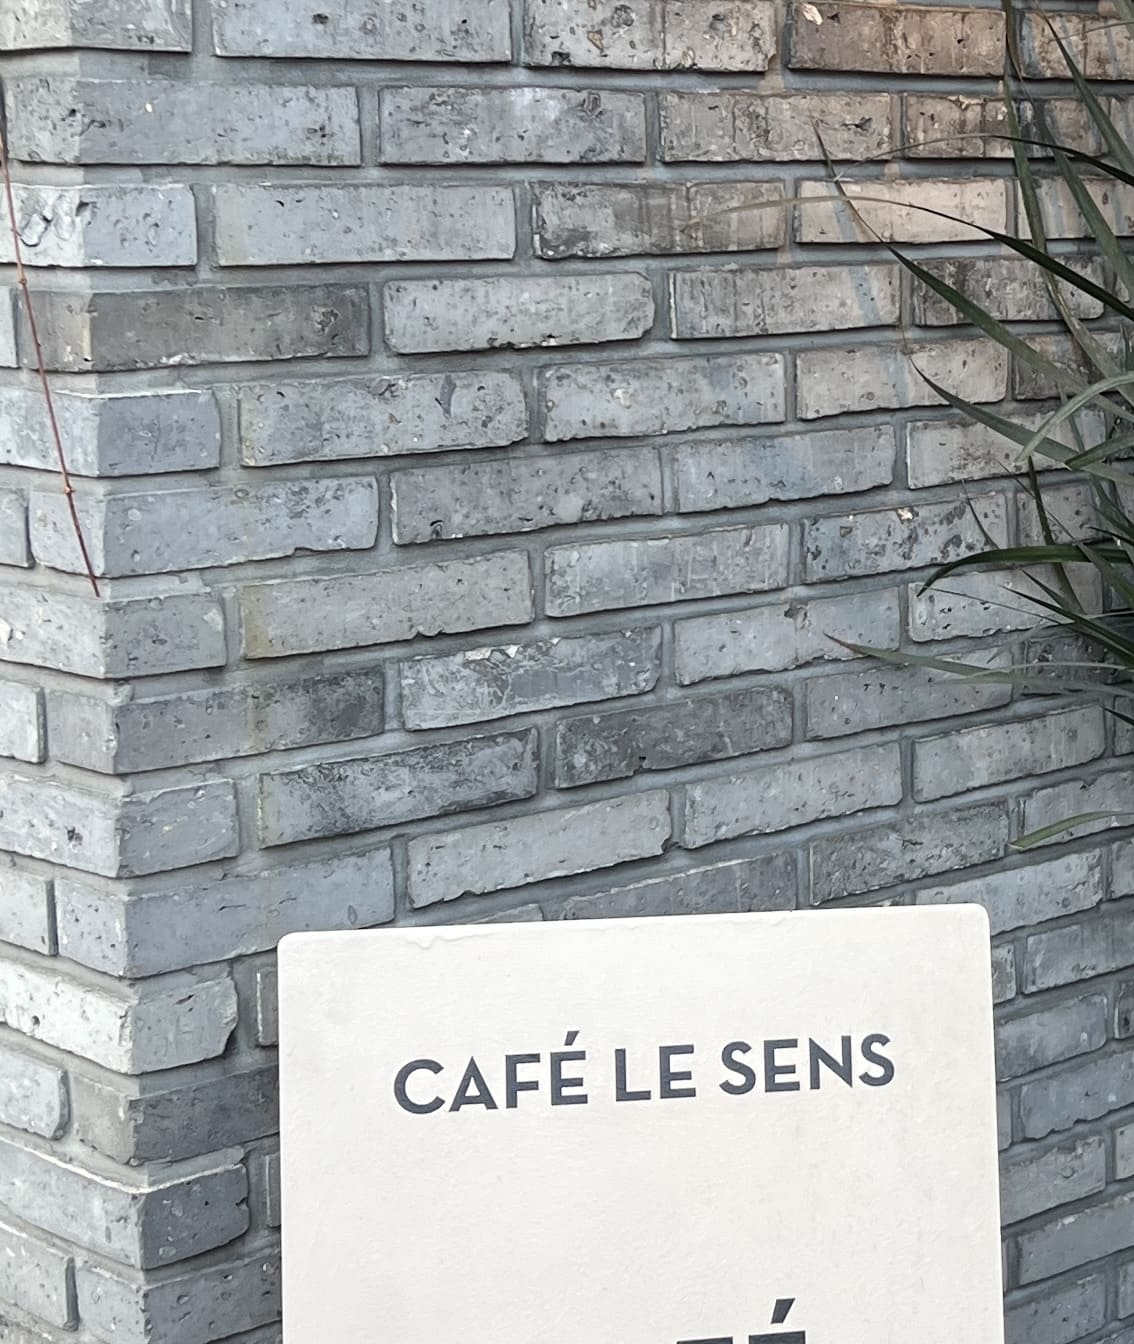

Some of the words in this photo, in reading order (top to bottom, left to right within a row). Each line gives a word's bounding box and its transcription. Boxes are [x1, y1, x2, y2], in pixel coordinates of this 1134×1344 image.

[394, 1030, 588, 1115] CAFÉ
[614, 1043, 697, 1102] LE
[719, 1033, 896, 1095] SENS
